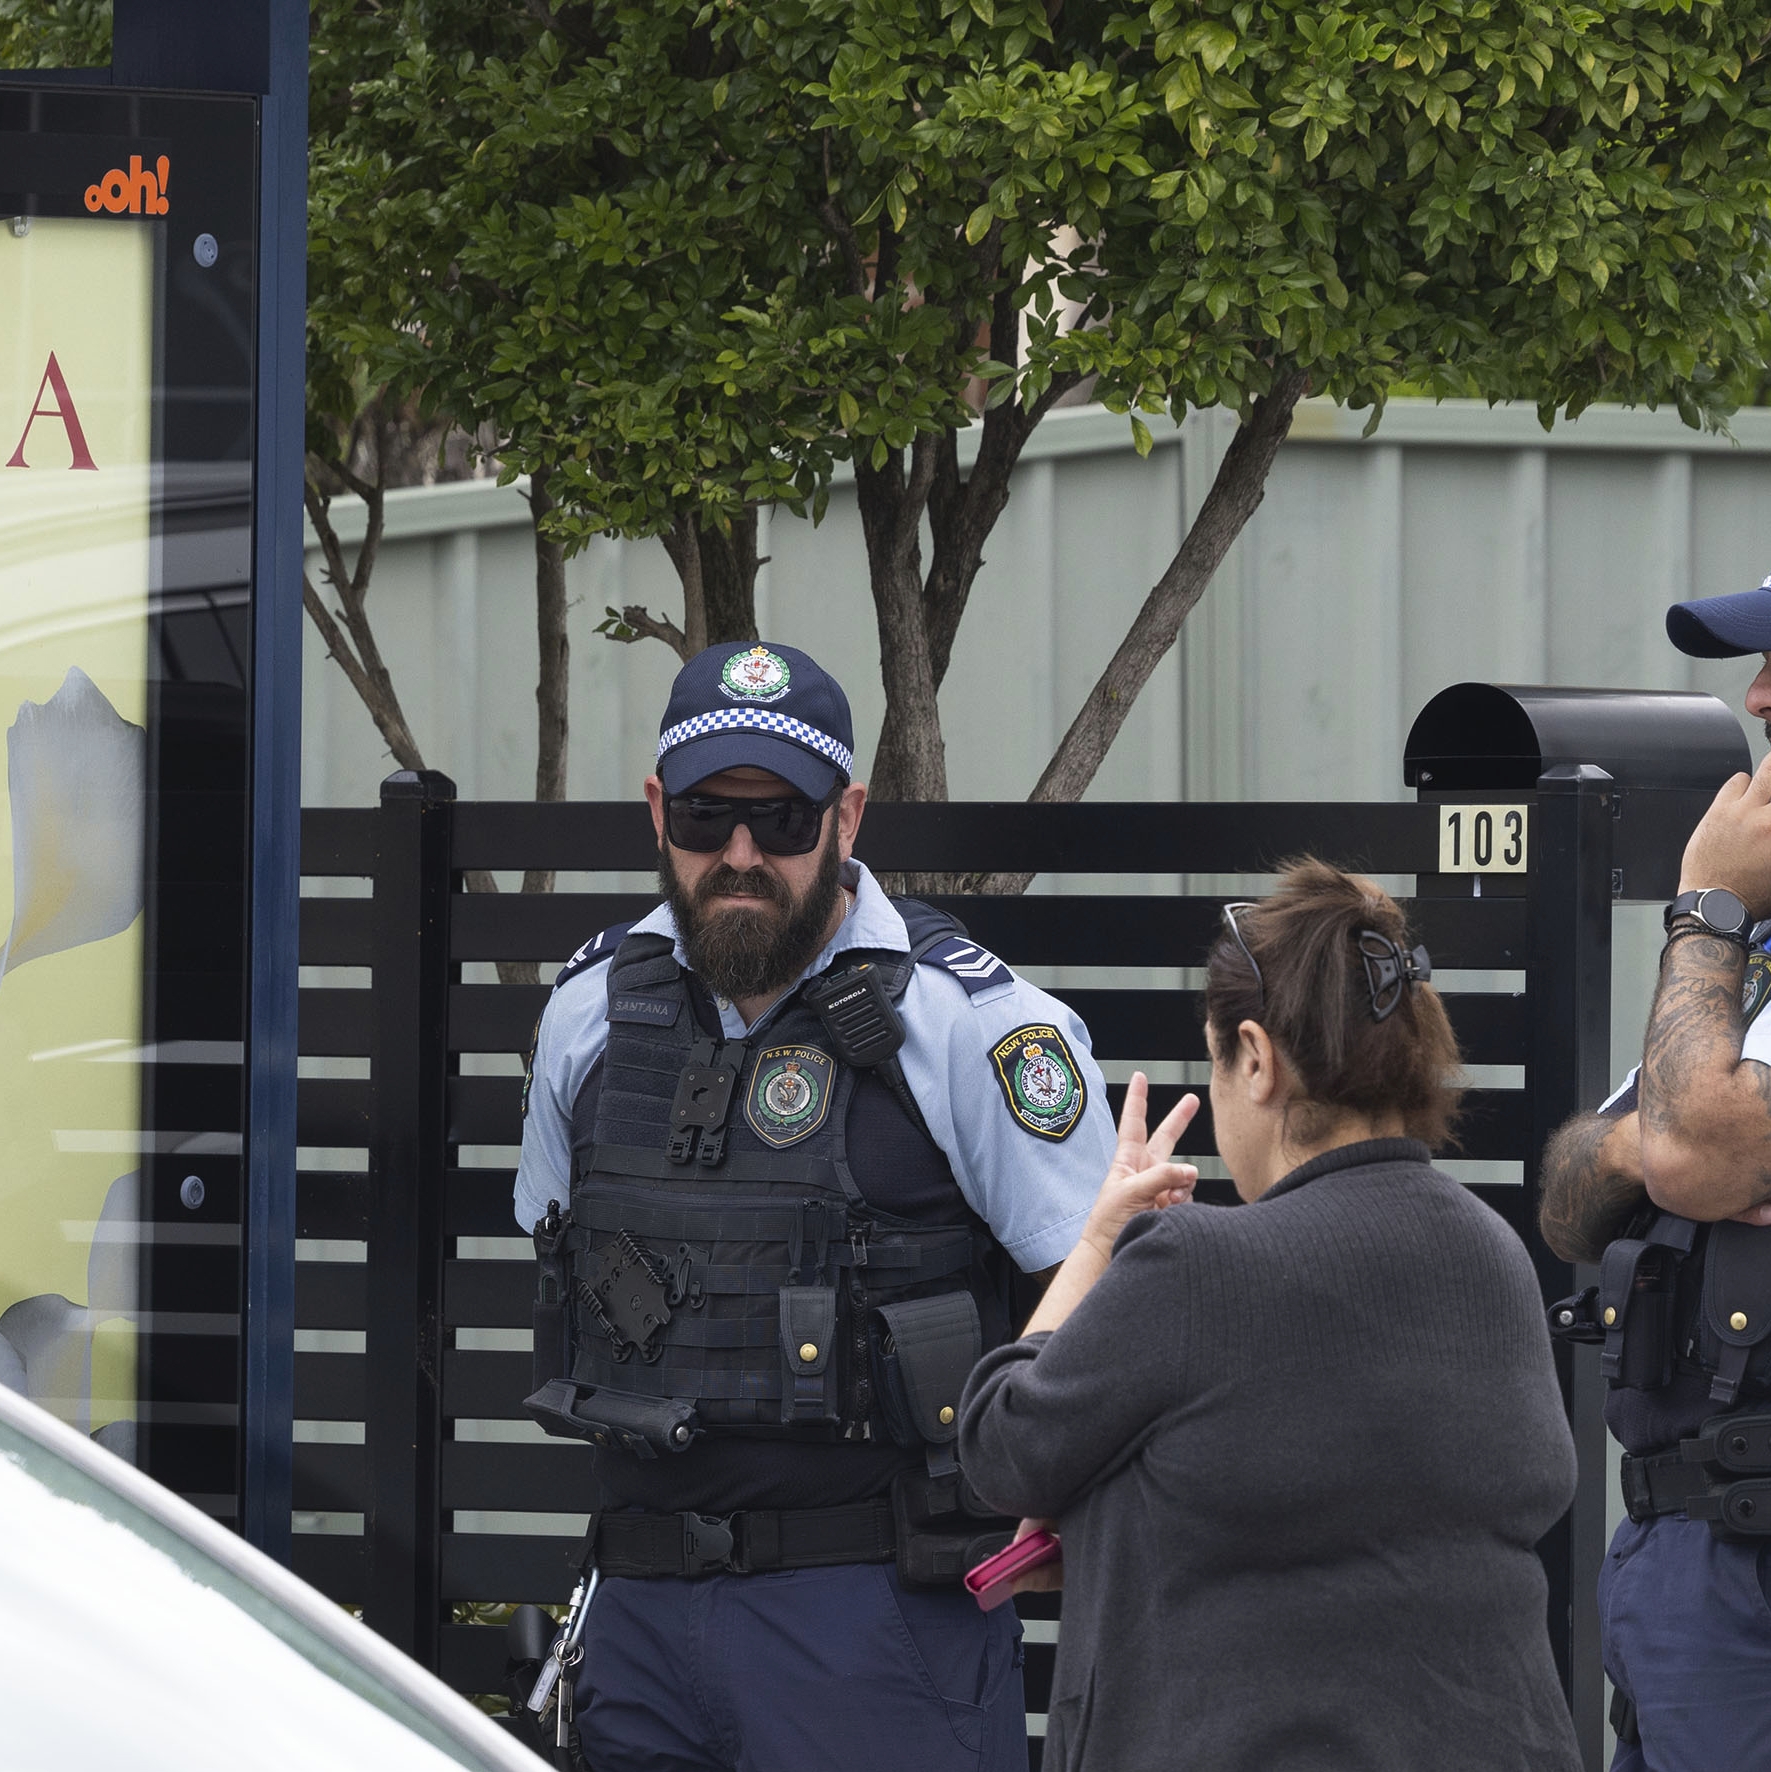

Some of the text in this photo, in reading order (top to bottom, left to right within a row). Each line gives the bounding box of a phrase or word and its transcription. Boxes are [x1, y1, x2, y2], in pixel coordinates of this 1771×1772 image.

[1448, 810, 1523, 867] 103
[1021, 1030, 1055, 1043] POLICE
[794, 1049, 827, 1067] POLICE
[1028, 1081, 1066, 1107] POLICE FORCE
